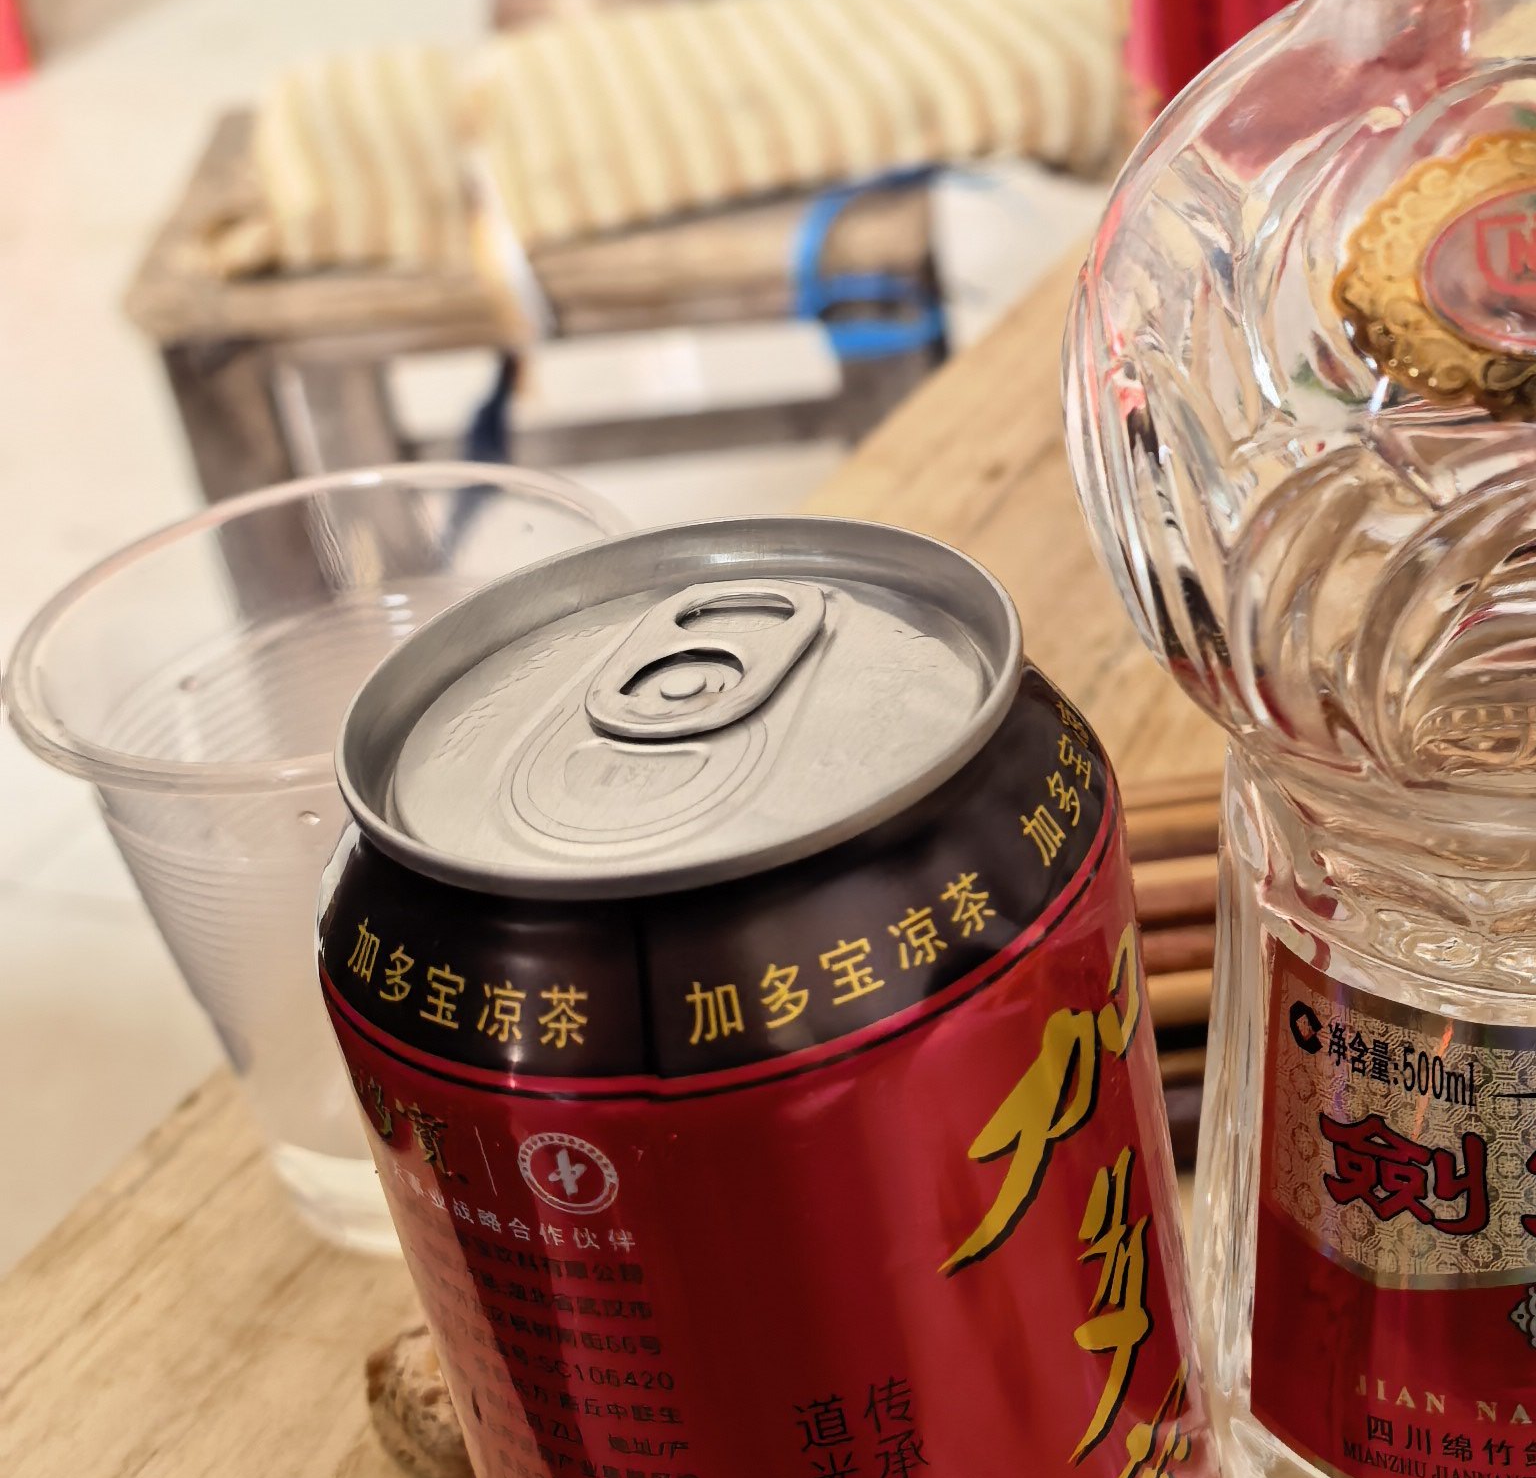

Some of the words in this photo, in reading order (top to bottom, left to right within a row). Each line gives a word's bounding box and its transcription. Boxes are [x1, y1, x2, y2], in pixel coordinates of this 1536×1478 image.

[347, 918, 590, 1049] 加多宝凉茶
[685, 871, 997, 1046] 加多宝凉茶
[1328, 1021, 1478, 1107] 净含量:500ml
[1354, 1374, 1446, 1415] JIAN
